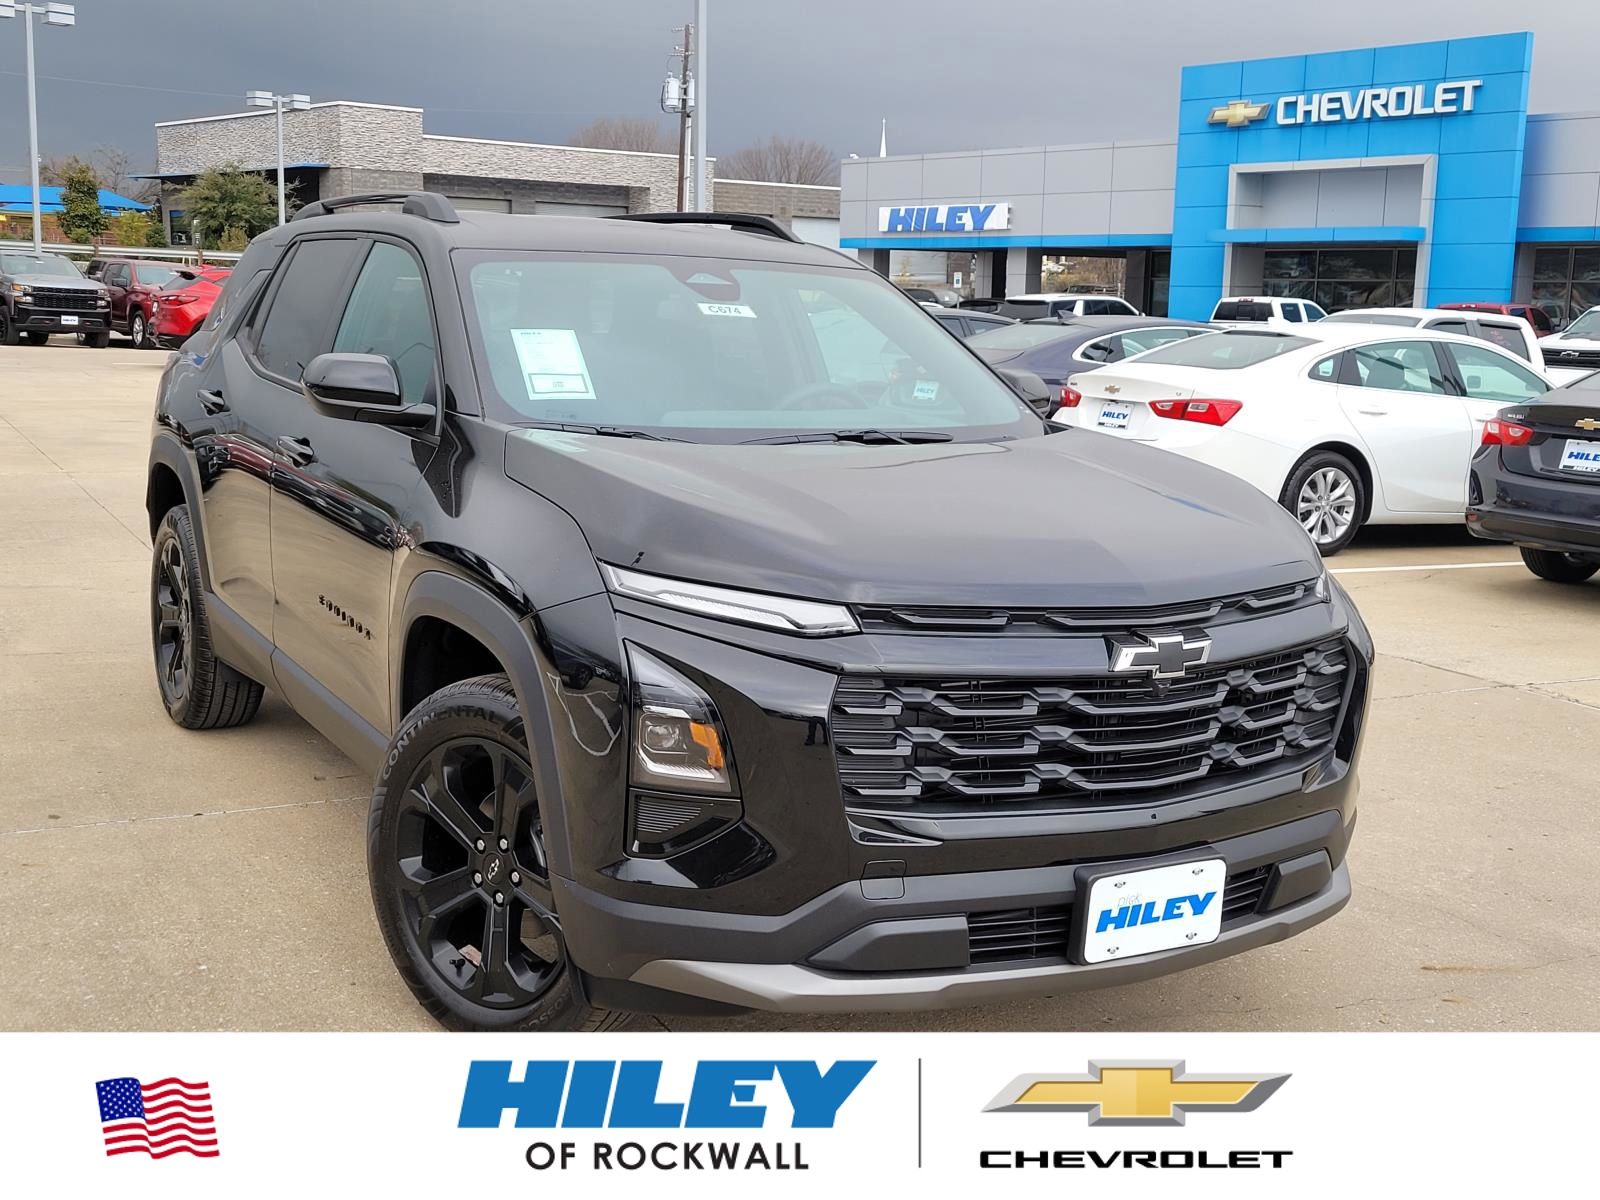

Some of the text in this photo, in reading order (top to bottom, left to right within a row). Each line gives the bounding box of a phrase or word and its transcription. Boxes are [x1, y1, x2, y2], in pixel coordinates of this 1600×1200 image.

[1276, 79, 1484, 126] CHEVROLET
[887, 205, 996, 232] HILEY
[1102, 410, 1128, 420] HILEY
[1095, 892, 1217, 933] HILEY
